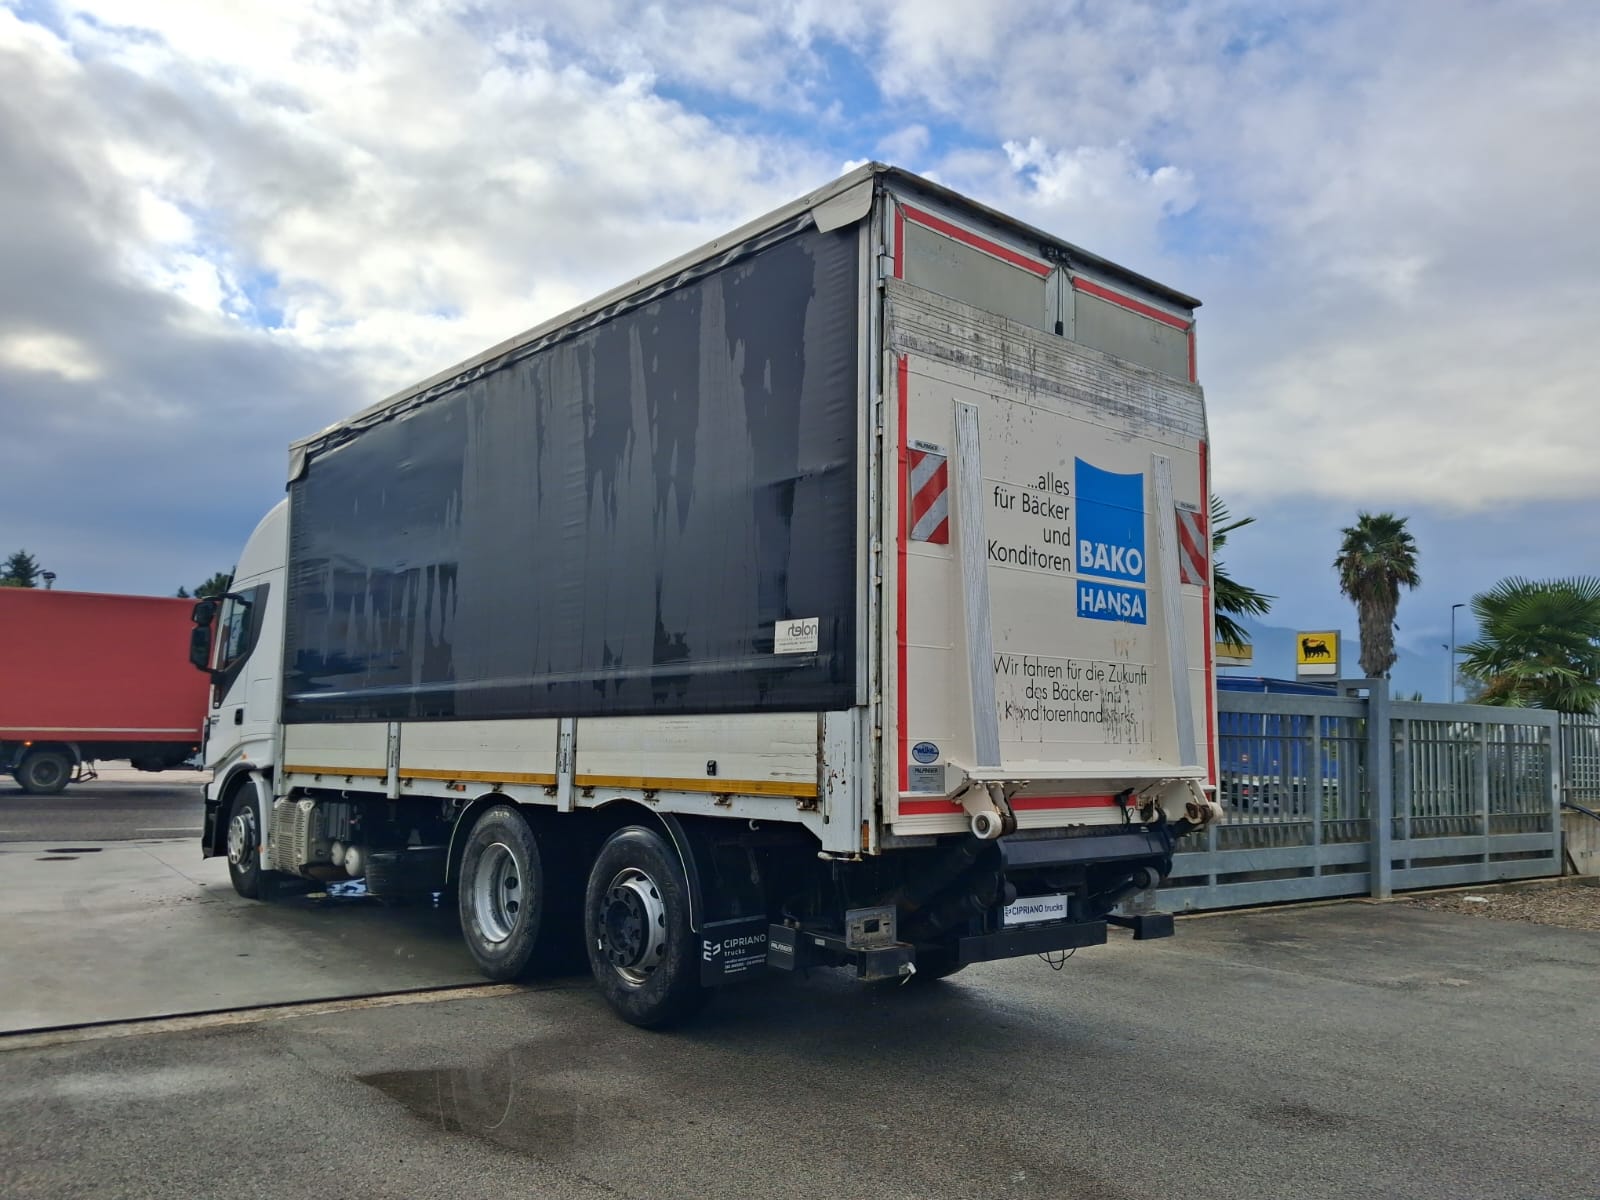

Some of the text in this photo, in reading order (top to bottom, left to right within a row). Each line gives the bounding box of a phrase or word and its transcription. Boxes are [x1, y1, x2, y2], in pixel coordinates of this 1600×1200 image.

[1027, 472, 1070, 496] ...alles
[993, 485, 1070, 521] für Bäcker
[1043, 526, 1071, 546] und
[987, 539, 1071, 572] Konditoren
[1080, 540, 1143, 576] BÄKO
[1081, 587, 1145, 618] HANSA
[993, 655, 1149, 686] Wir fahren für die Zukunft
[1052, 681, 1099, 702] Bäcker-
[1012, 903, 1065, 916] CIPRIANO trucks
[723, 933, 767, 949] CIPRIANO
[723, 948, 746, 957] trucks
